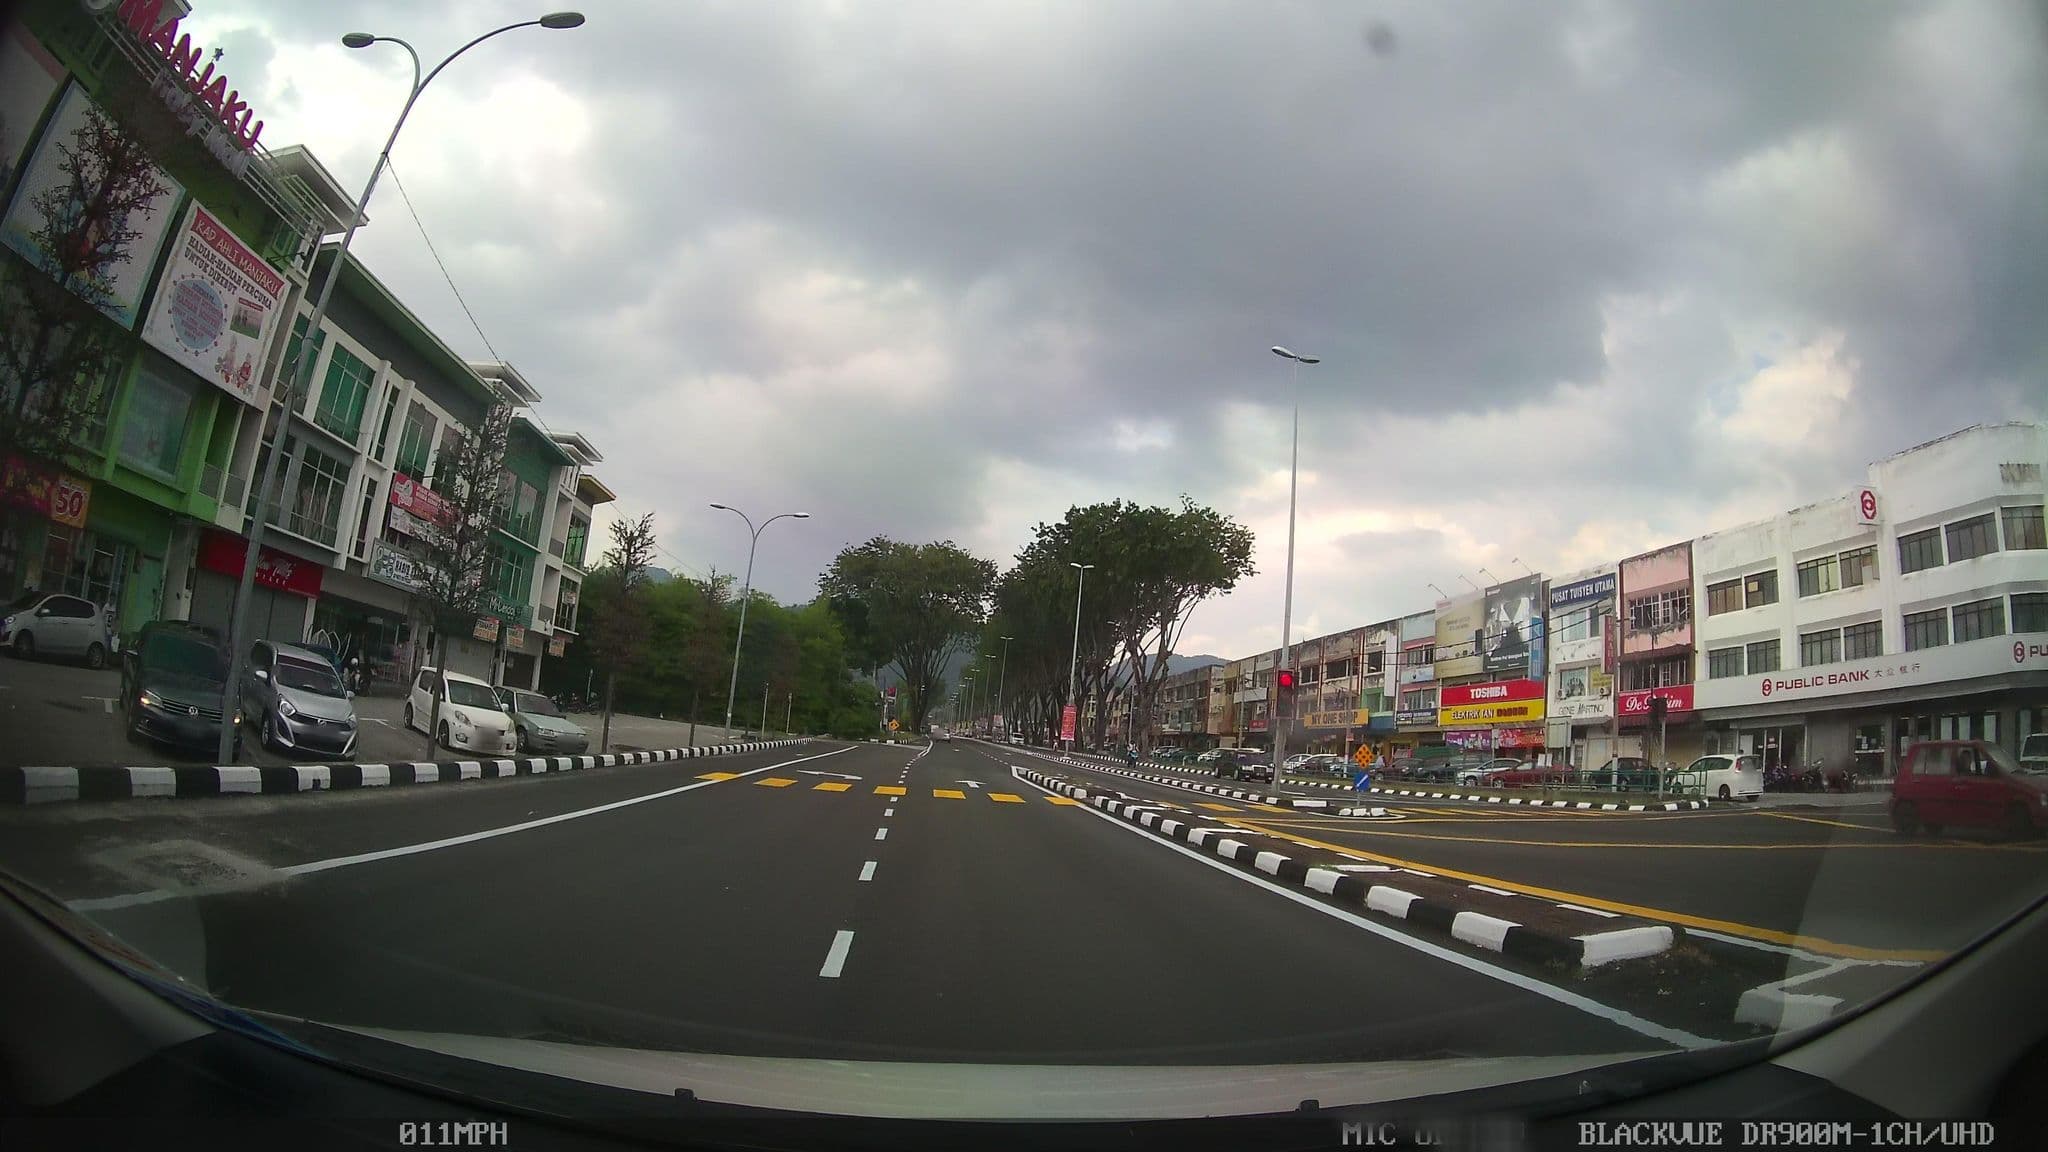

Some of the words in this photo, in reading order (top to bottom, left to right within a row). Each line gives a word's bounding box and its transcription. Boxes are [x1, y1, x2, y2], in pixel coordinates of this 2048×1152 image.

[184, 246, 210, 273] UNTUK
[195, 219, 217, 241] KAD
[216, 239, 239, 259] AHLI
[239, 256, 279, 294] MANJAKU
[187, 235, 243, 286] HADIAH-HADIAH
[242, 279, 273, 310] PERCUMA
[55, 486, 83, 518] 50
[1551, 589, 1569, 604] PUSAT
[1594, 577, 1615, 594] UTAMA
[1470, 685, 1507, 700] TOSHIBA
[1776, 676, 1824, 691] PUBLIC
[1828, 669, 1870, 685] BANK
[1451, 709, 1480, 720] ELEKTRIK
